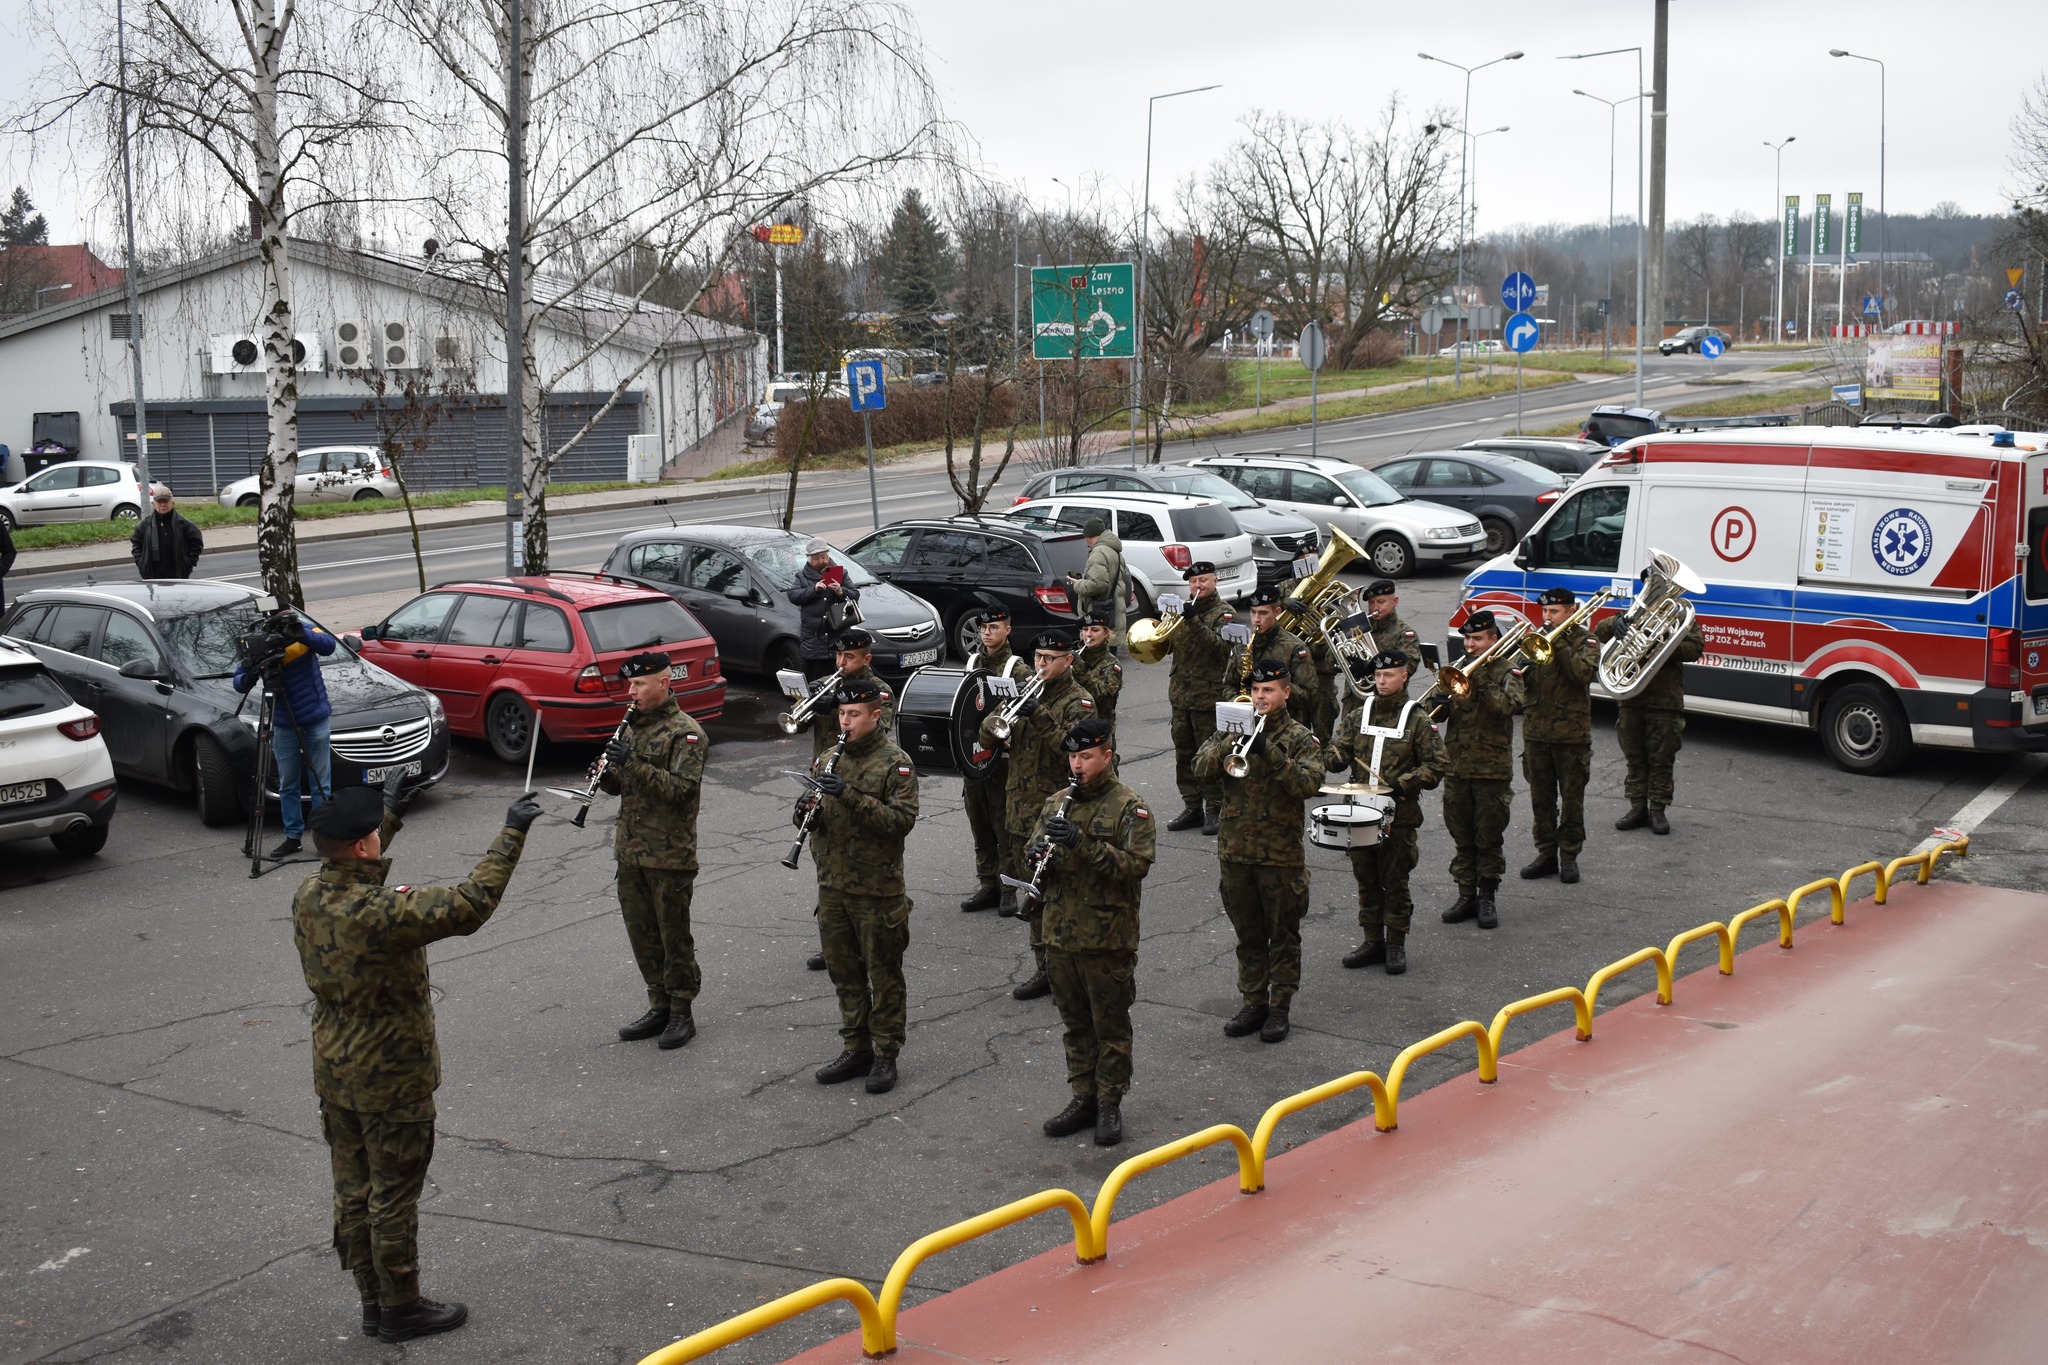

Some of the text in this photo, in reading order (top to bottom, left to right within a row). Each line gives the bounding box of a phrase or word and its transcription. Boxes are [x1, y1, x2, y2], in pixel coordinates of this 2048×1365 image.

[1092, 268, 1112, 282] Żary
[1092, 286, 1124, 295] Leszno
[856, 366, 876, 404] P
[1724, 518, 1744, 550] P
[1908, 512, 1930, 557] RATOWNICTWO
[1881, 560, 1918, 574] MEDYCZNE
[1702, 624, 1764, 639] Szpital Wojskowy
[1704, 634, 1714, 642] SP
[1716, 636, 1732, 644] ZOZ
[1740, 637, 1766, 648] Żarach
[904, 654, 916, 664] FZG
